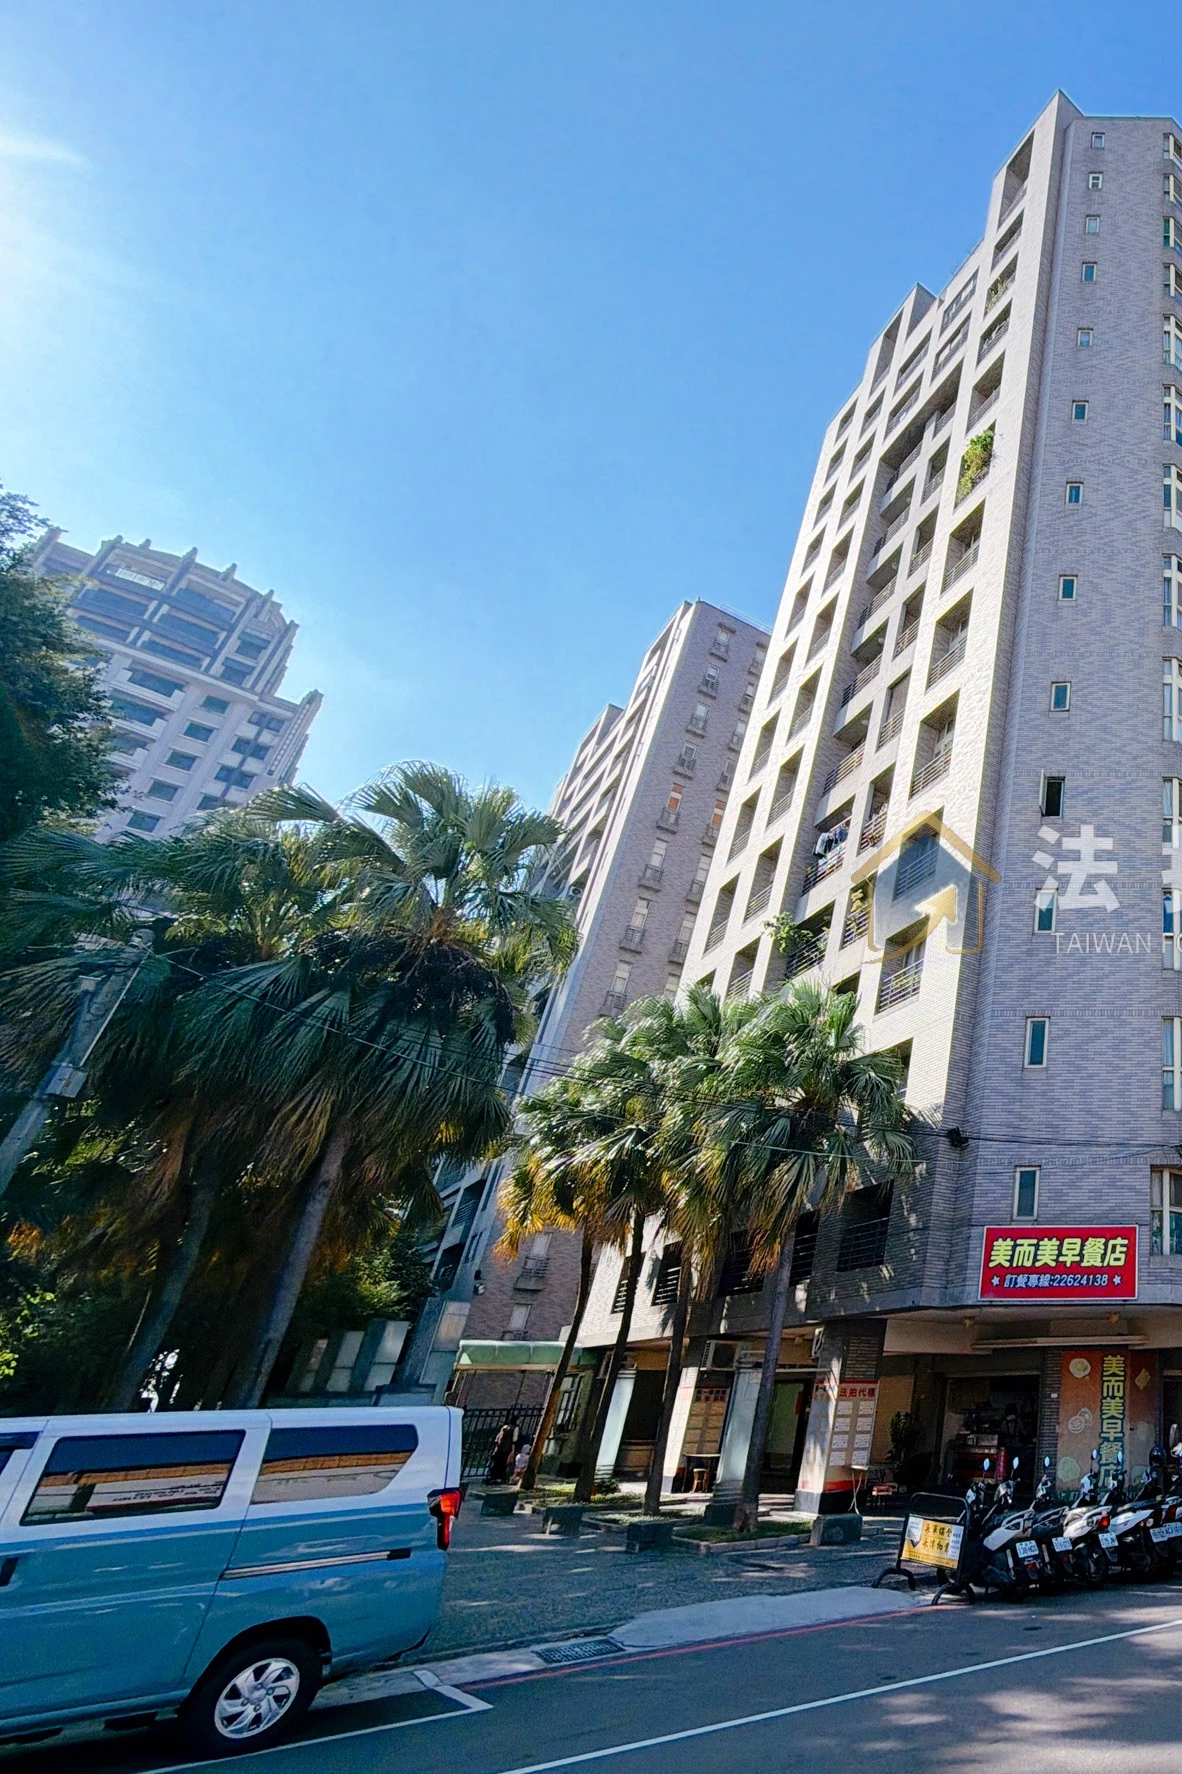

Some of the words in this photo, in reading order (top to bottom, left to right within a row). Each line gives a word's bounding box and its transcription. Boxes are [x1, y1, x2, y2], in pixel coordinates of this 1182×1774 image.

[988, 1237, 1129, 1268] 美而美早餐店
